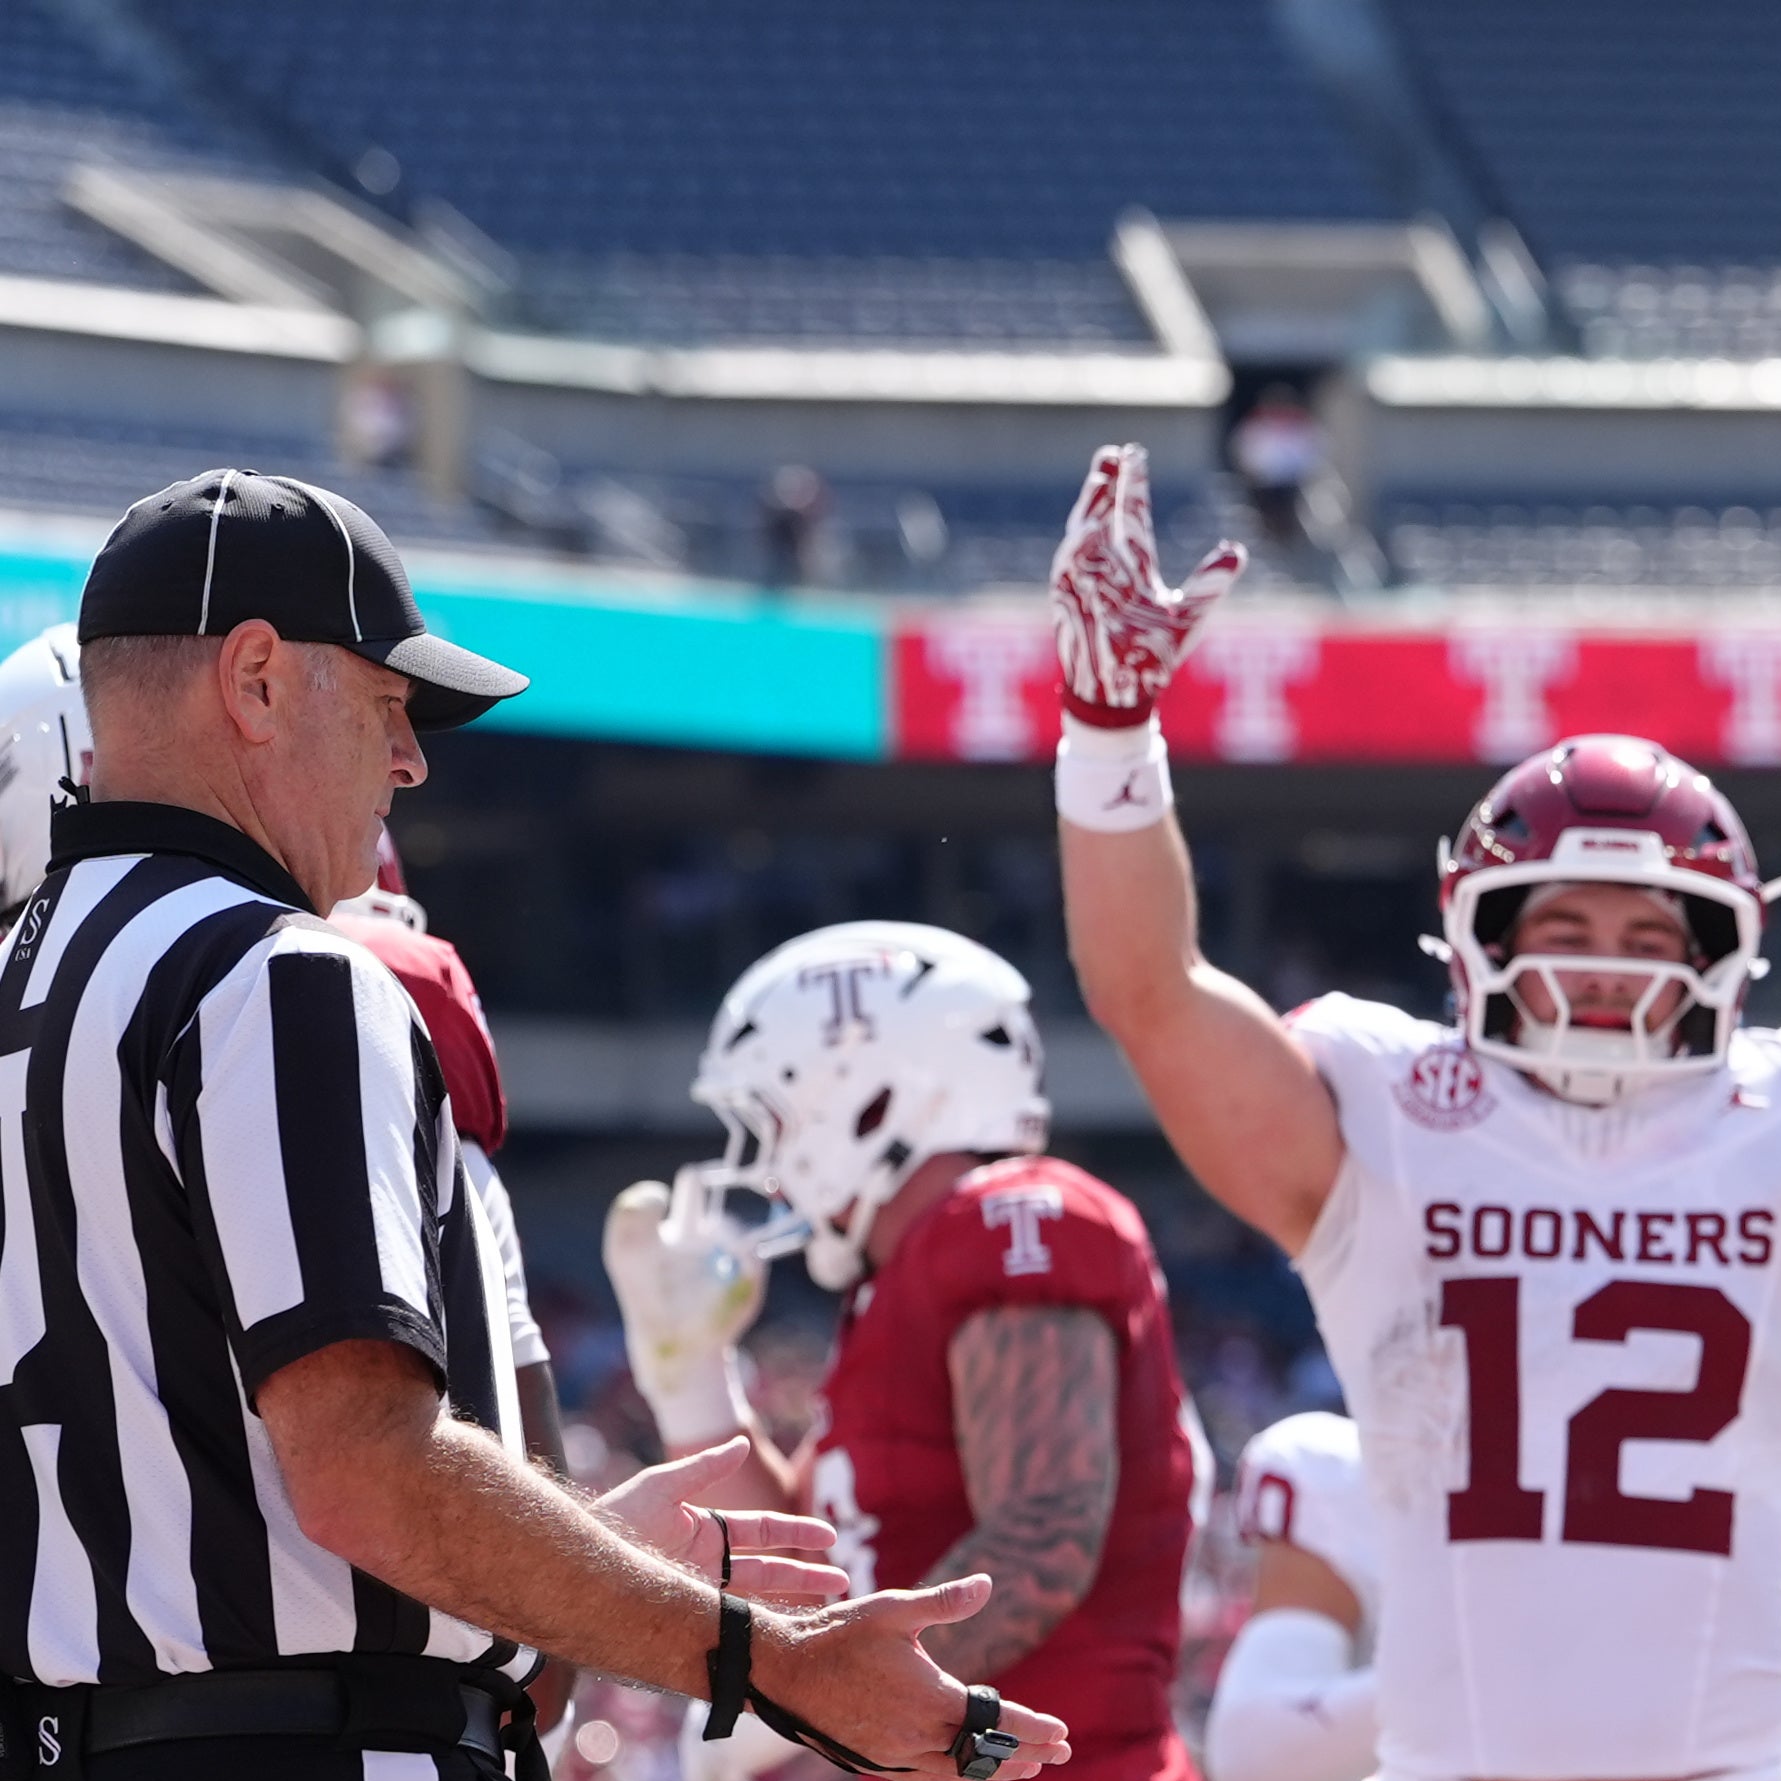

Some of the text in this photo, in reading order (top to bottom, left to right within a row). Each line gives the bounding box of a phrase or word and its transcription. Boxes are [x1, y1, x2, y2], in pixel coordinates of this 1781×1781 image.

[1450, 630, 1578, 766] T
[798, 955, 892, 1048] T
[1414, 1051, 1481, 1112] SEC
[980, 1185, 1064, 1277] T
[1425, 1202, 1776, 1267] SOONERS
[1439, 1275, 1753, 1558] 12
